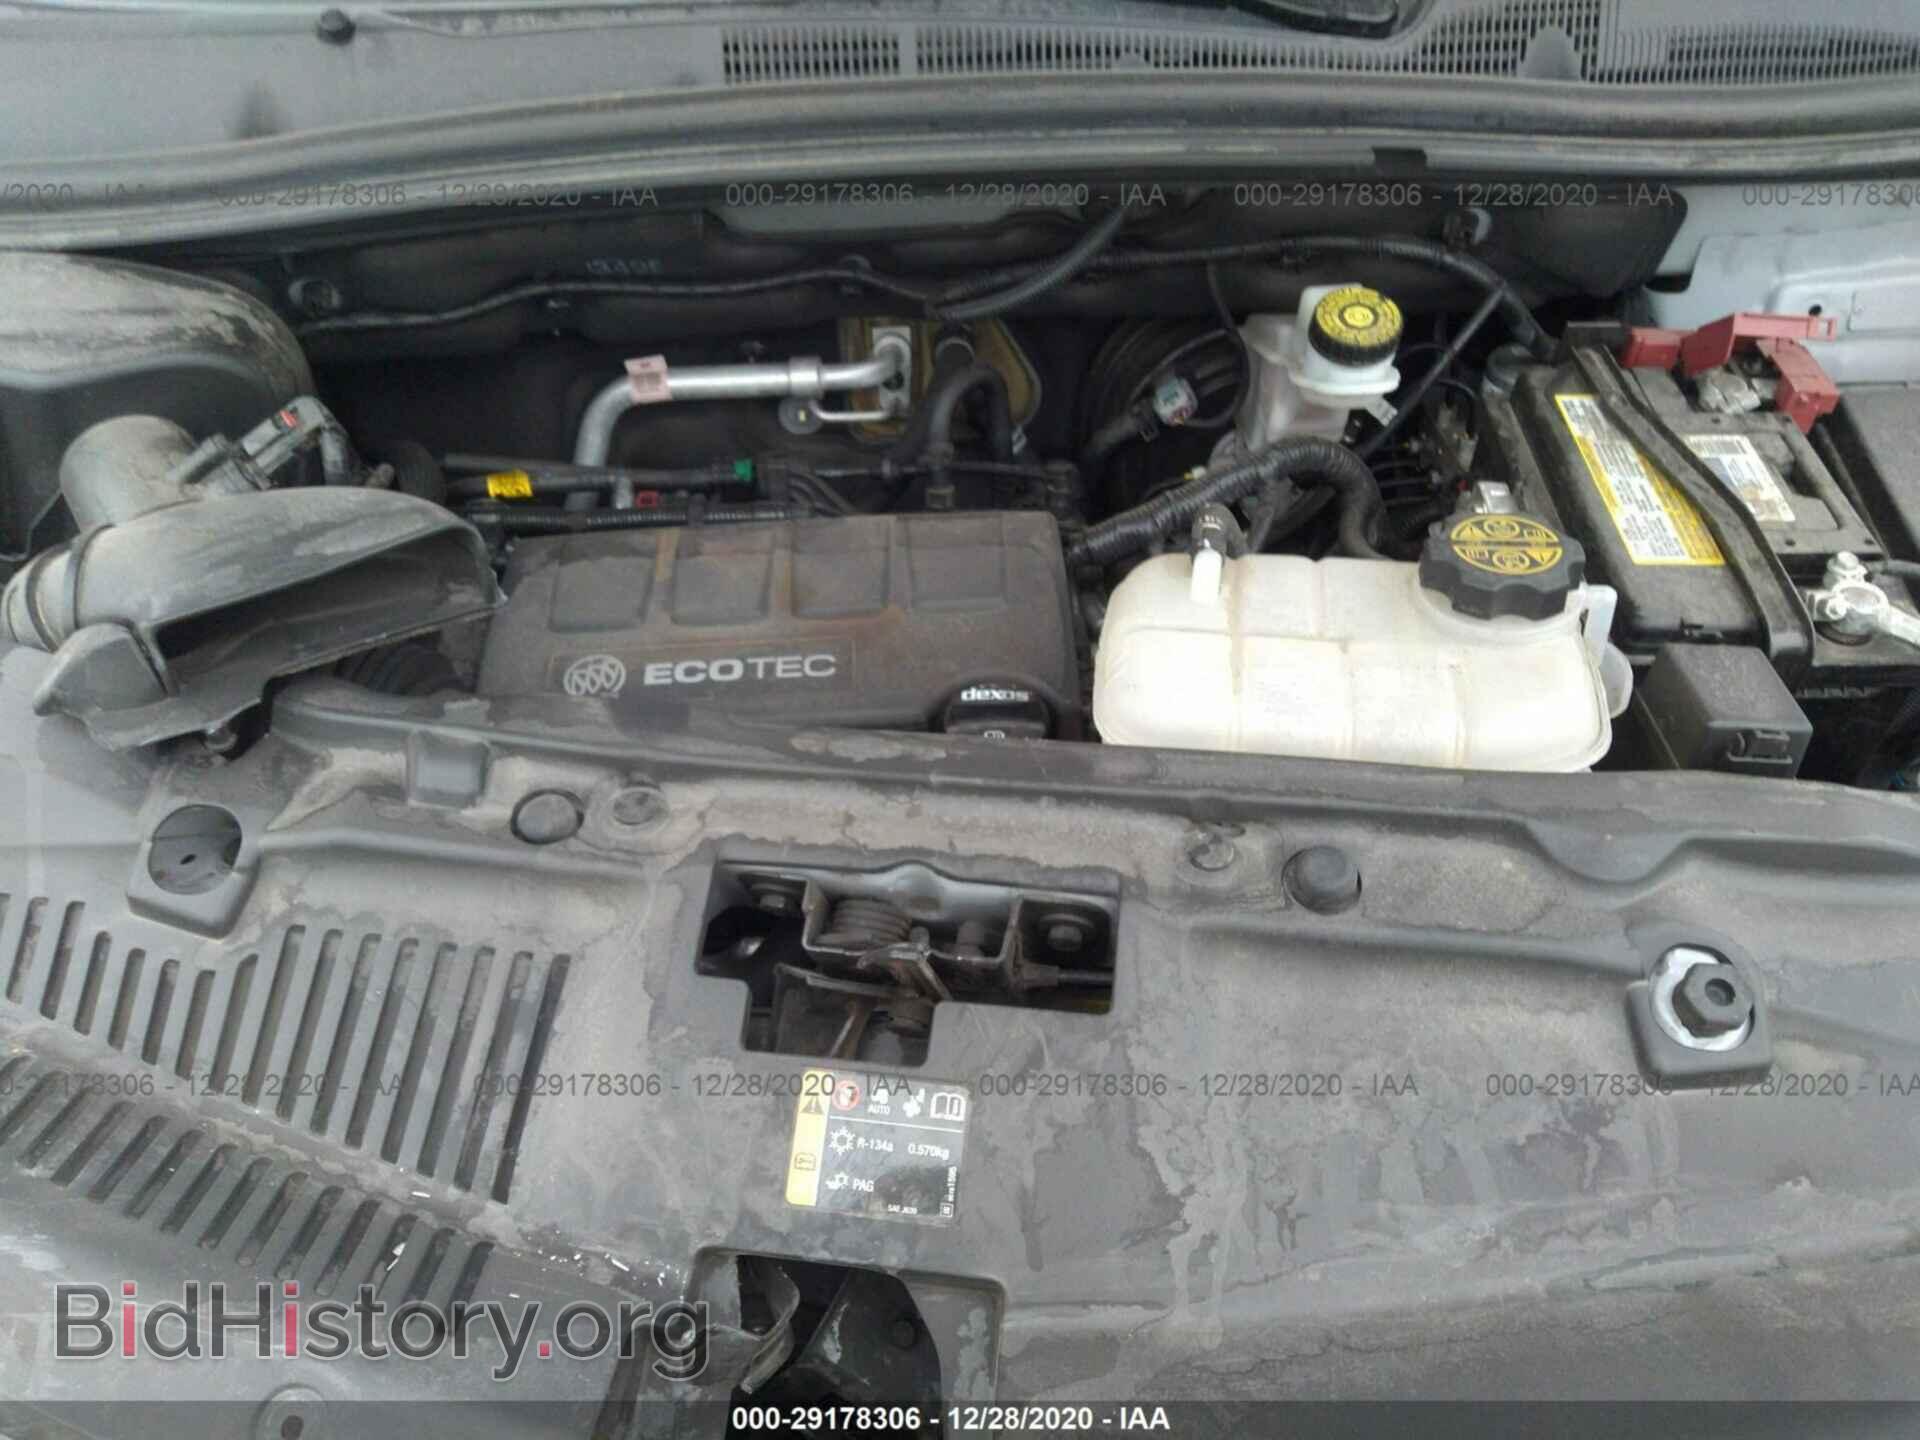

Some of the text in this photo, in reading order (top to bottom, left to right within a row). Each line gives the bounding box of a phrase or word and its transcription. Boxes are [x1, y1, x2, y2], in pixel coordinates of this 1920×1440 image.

[643, 654, 837, 686] ECOTEC
[960, 687, 1030, 702] dexos
[852, 1178, 875, 1193] PAG
